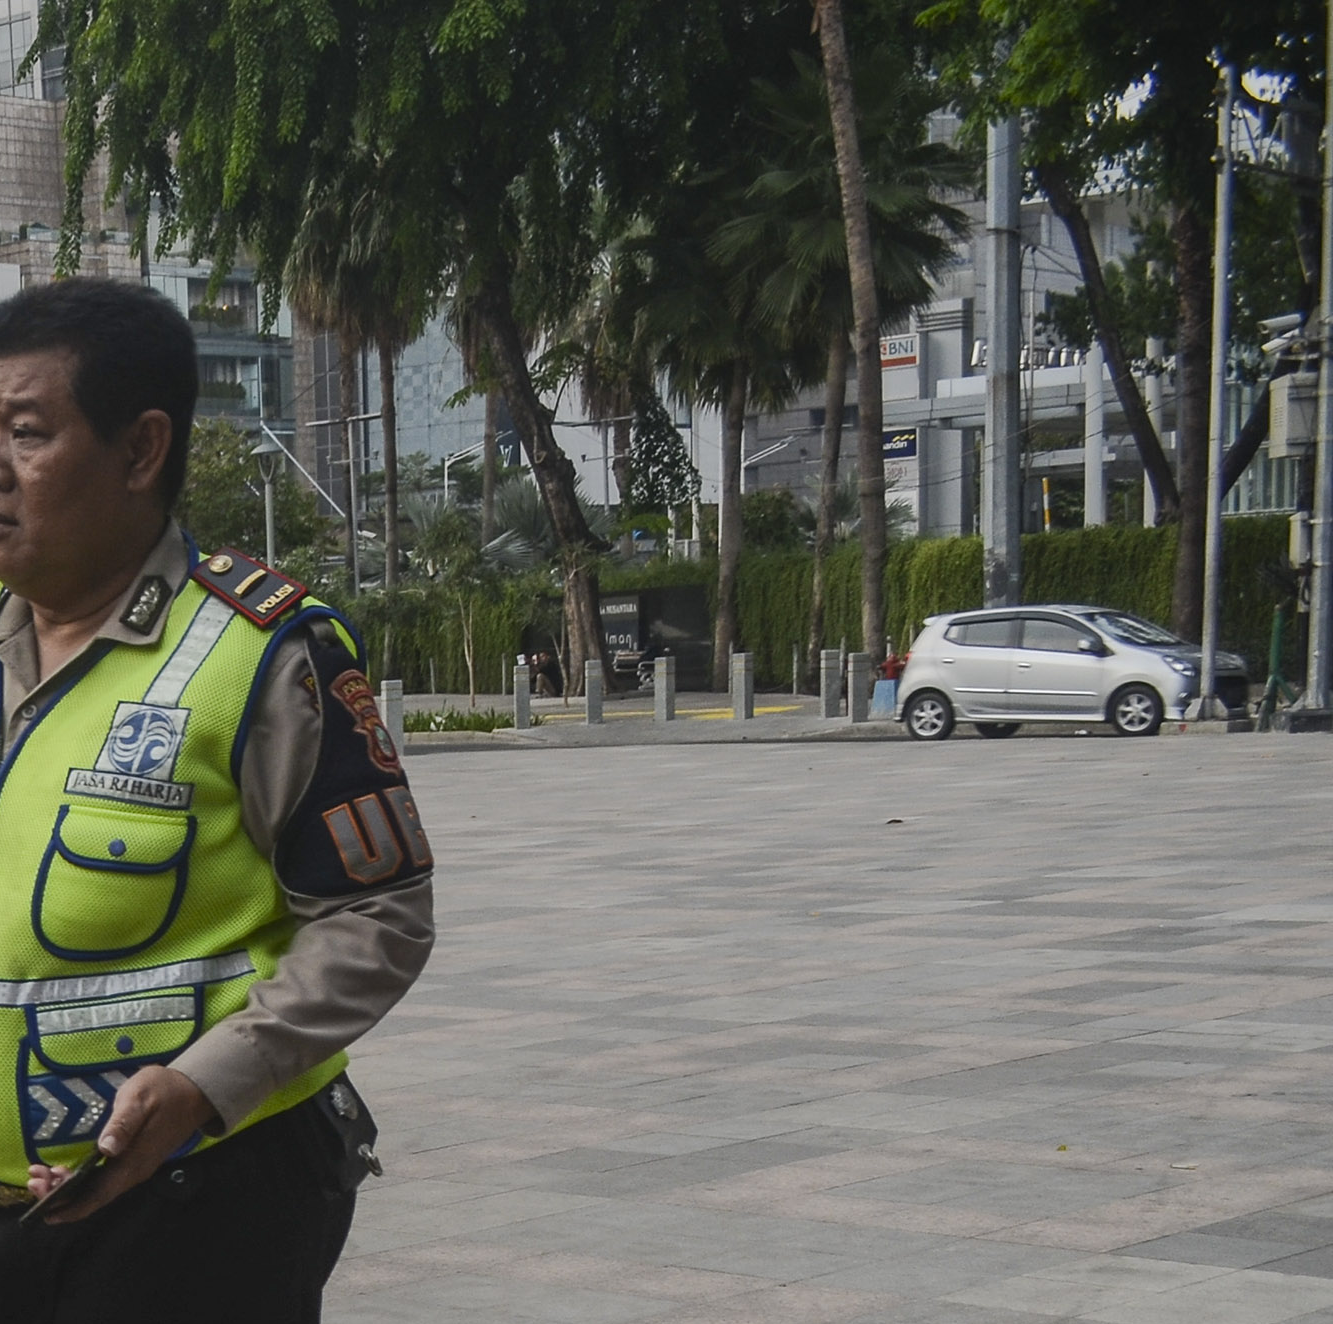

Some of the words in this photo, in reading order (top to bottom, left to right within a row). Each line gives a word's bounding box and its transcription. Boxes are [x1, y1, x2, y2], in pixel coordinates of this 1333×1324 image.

[889, 340, 914, 356] BNI
[255, 583, 295, 614] POLISI
[72, 772, 105, 788] JASA
[109, 776, 183, 803] RAHARJA
